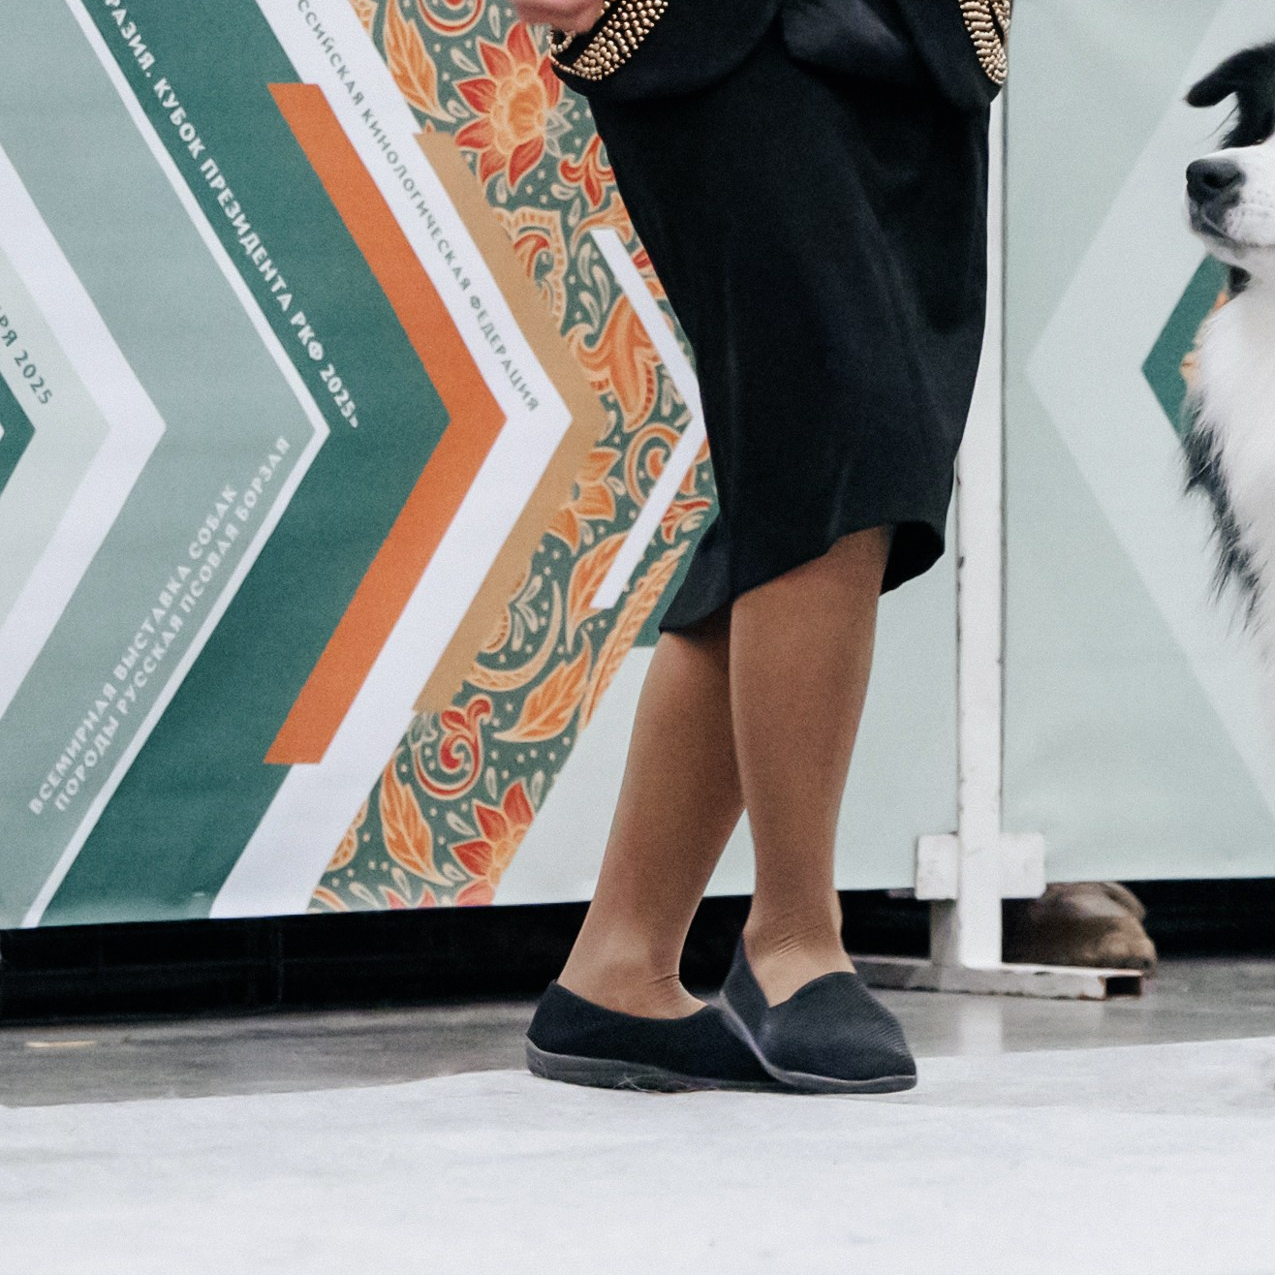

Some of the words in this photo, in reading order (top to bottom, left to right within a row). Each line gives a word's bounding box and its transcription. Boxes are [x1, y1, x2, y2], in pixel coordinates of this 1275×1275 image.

[14, 349, 53, 405] 2025
[154, 78, 205, 160] КУБОК
[200, 158, 294, 311] ПРЕЗИДЕНТА
[289, 310, 325, 362] РКФ
[320, 361, 360, 429] 2025»
[361, 105, 471, 291] КИНОЛОГИЧЕСКАЯ
[469, 294, 540, 412] ФЕДЕРАЦИЯ
[28, 681, 117, 816] ВСЕМИРНАЯ
[112, 564, 192, 680] ВЫСТАВКА
[188, 483, 239, 560] СОБАК
[55, 711, 120, 811] ПОРОДЫ
[117, 614, 185, 713] РУССКАЯ
[182, 523, 239, 614] ПСОВАЯ
[235, 436, 292, 523] БОРЗАЯ
